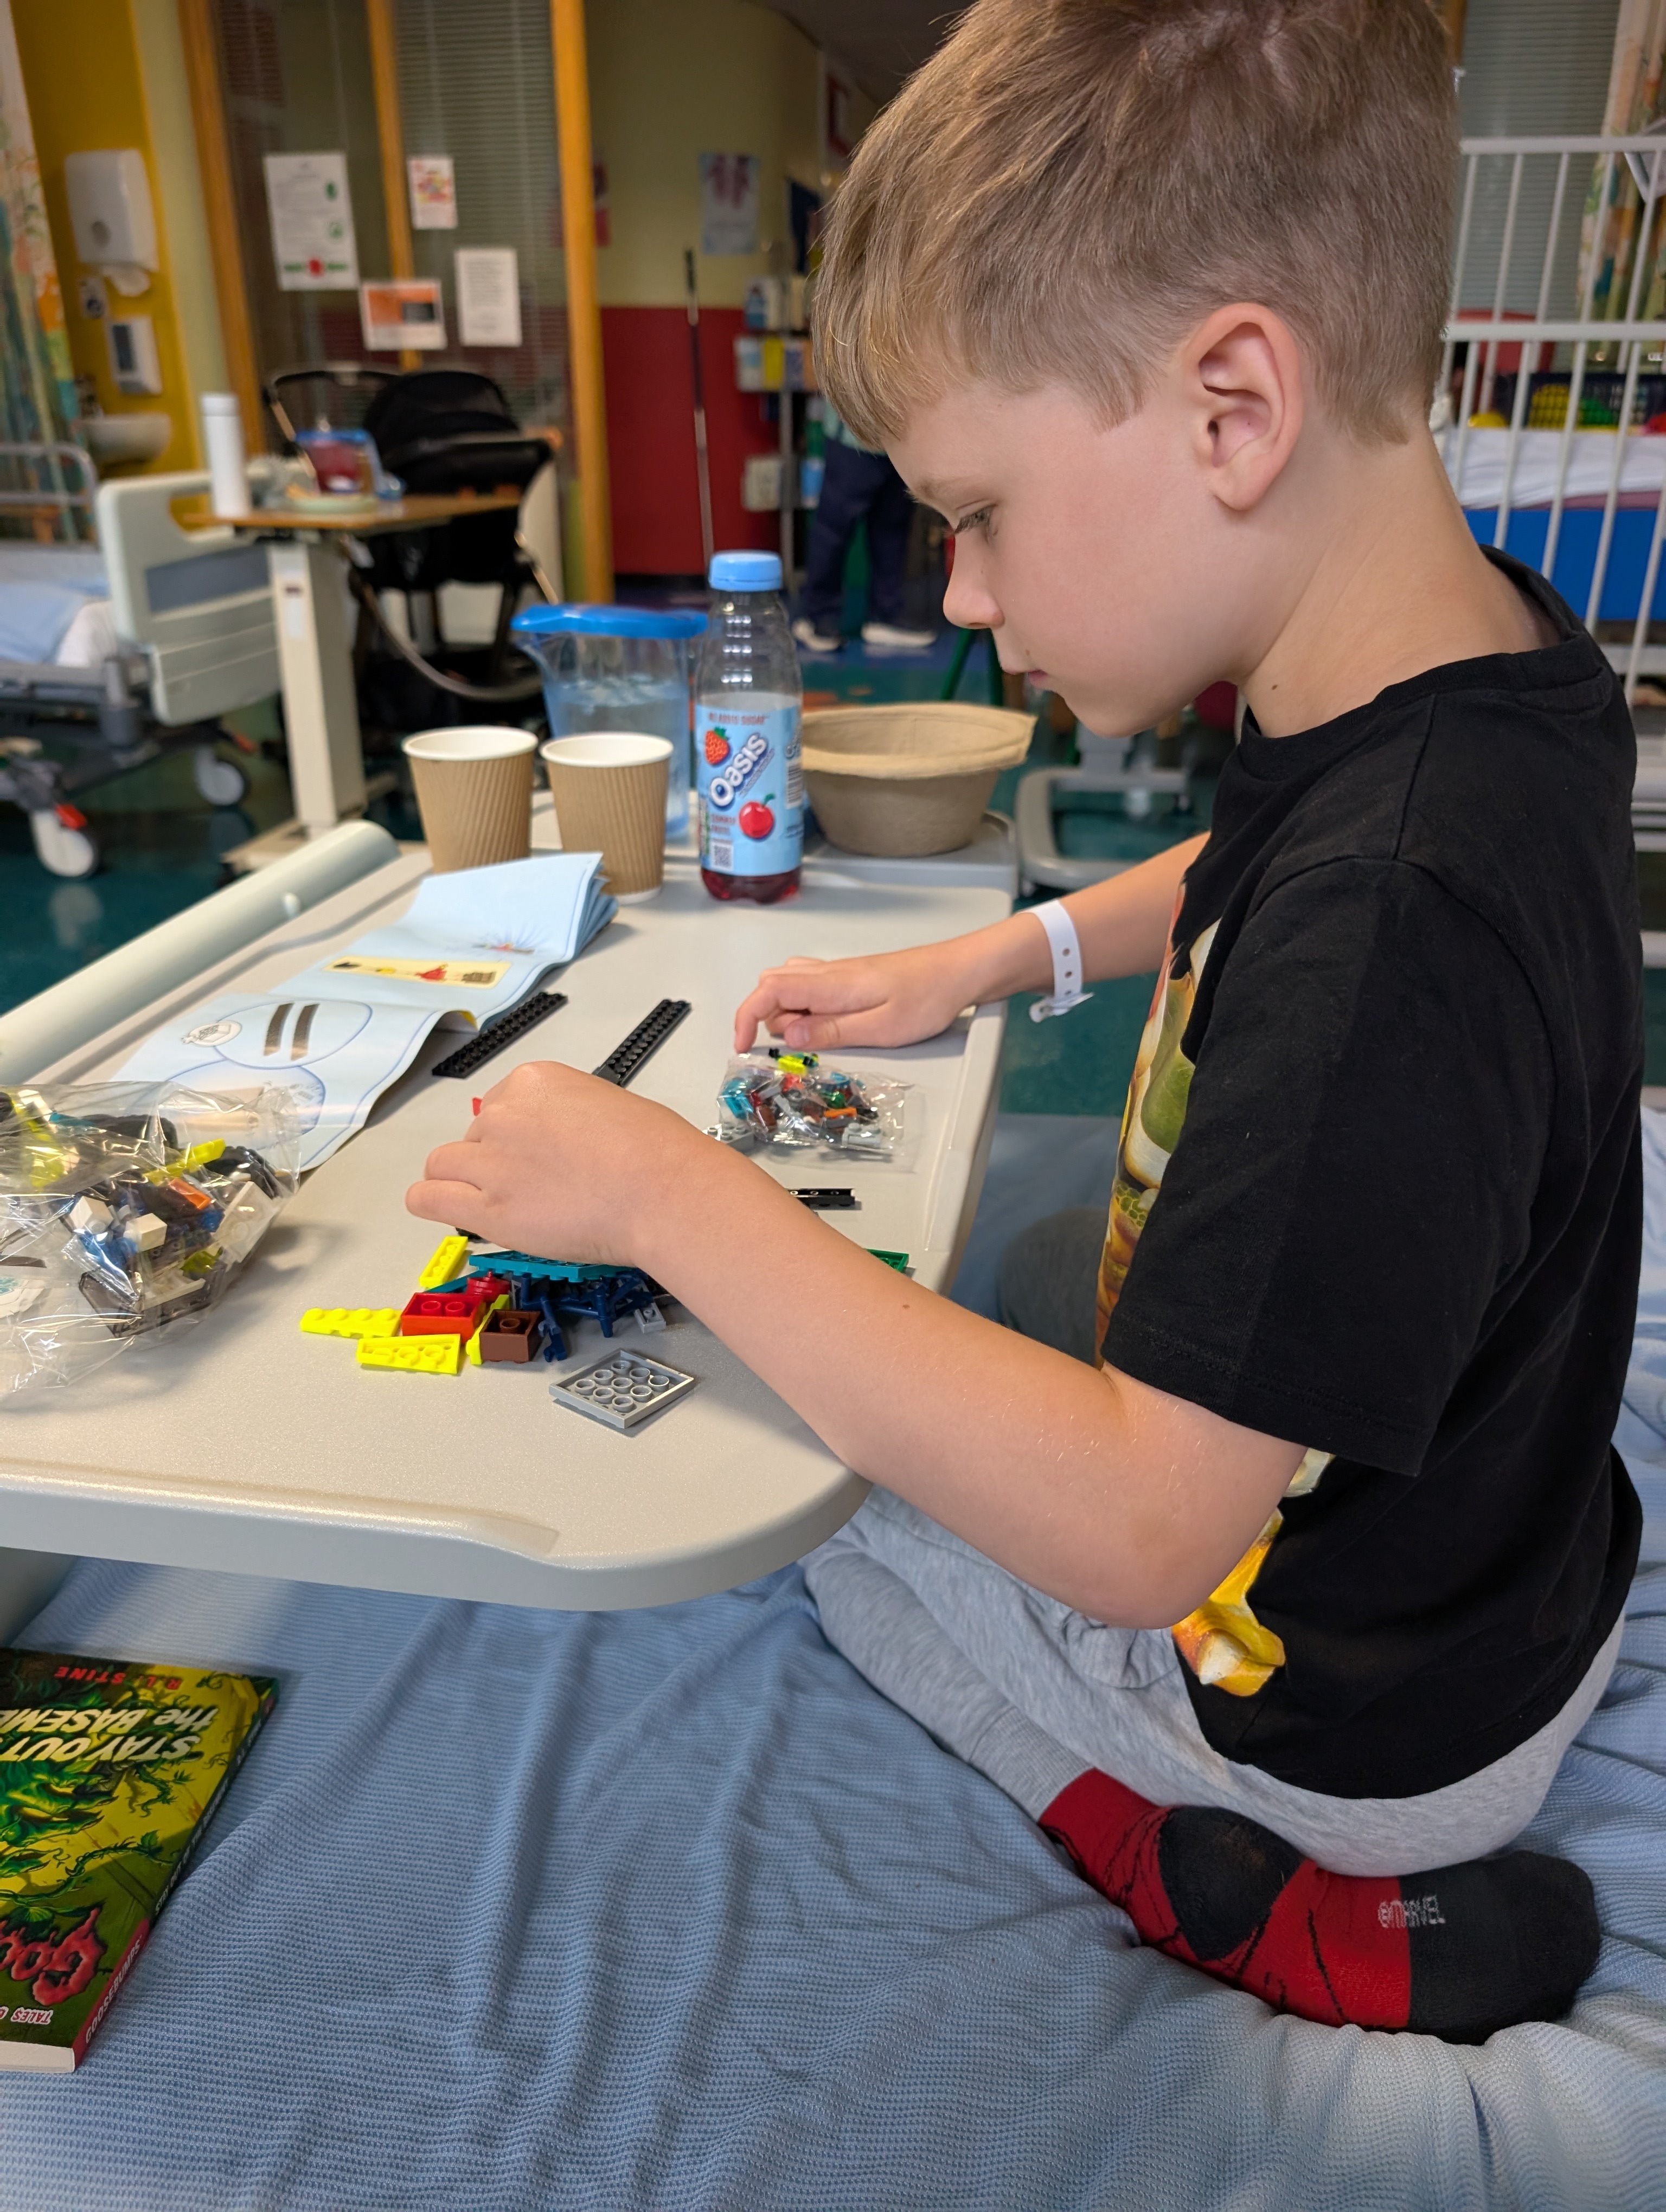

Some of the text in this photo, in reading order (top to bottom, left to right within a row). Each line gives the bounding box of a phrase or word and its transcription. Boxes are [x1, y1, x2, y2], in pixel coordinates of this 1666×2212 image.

[709, 732, 768, 808] Oasis
[55, 1666, 127, 1686] STINE
[153, 1707, 219, 1733] the
[0, 1735, 201, 1763] STAY OUT
[11, 2008, 53, 2024] TALES
